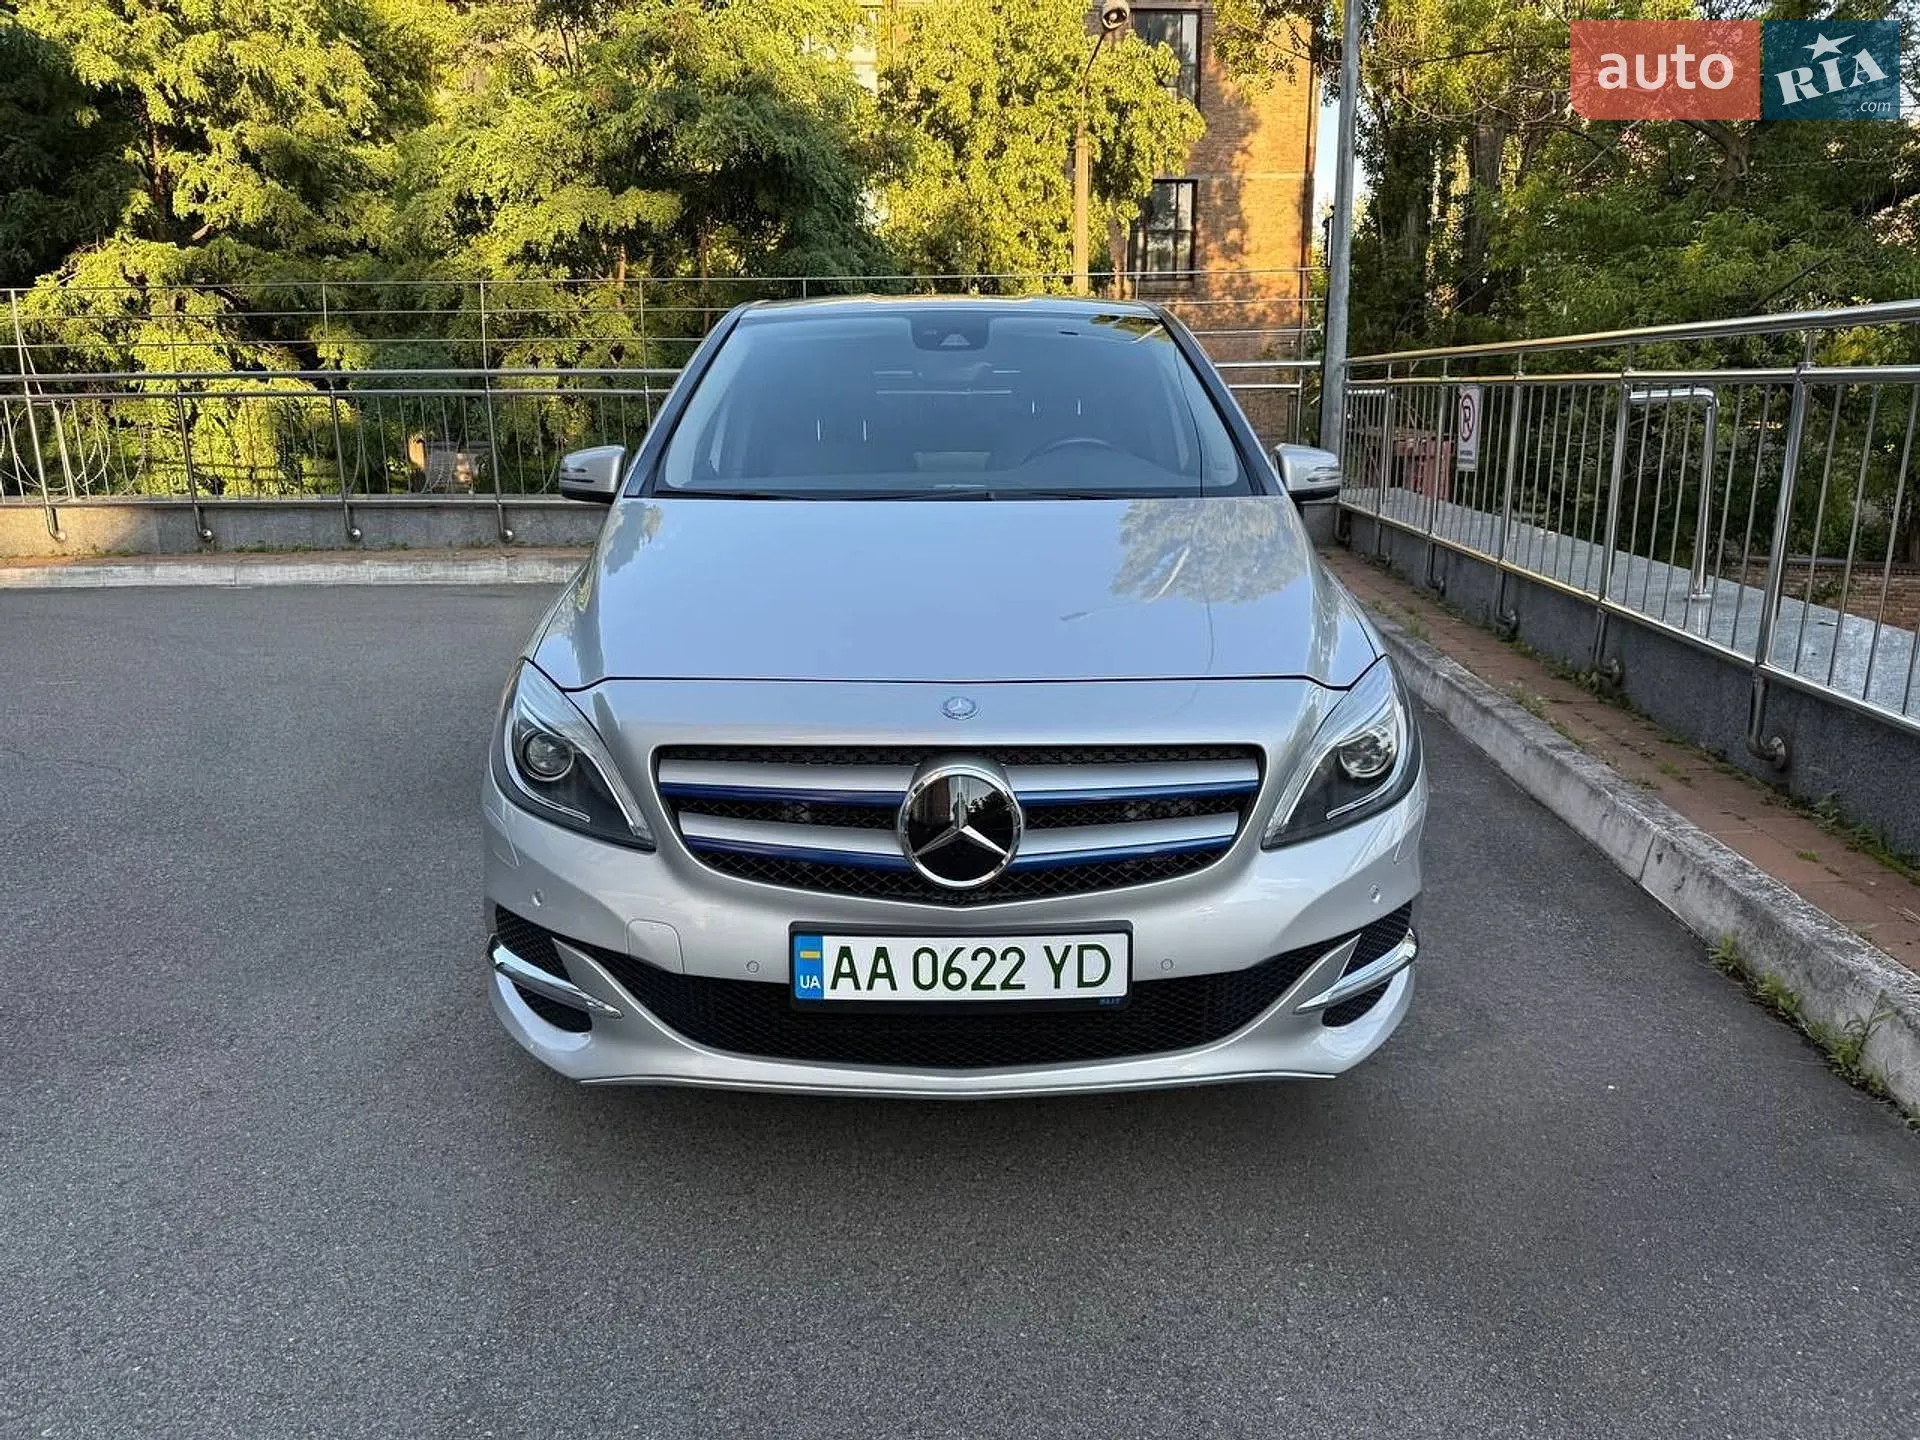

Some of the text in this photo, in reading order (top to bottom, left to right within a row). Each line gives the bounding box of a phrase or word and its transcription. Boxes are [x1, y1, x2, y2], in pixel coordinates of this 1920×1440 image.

[800, 975, 821, 989] UA
[830, 944, 1112, 991] AA 0622 YD
